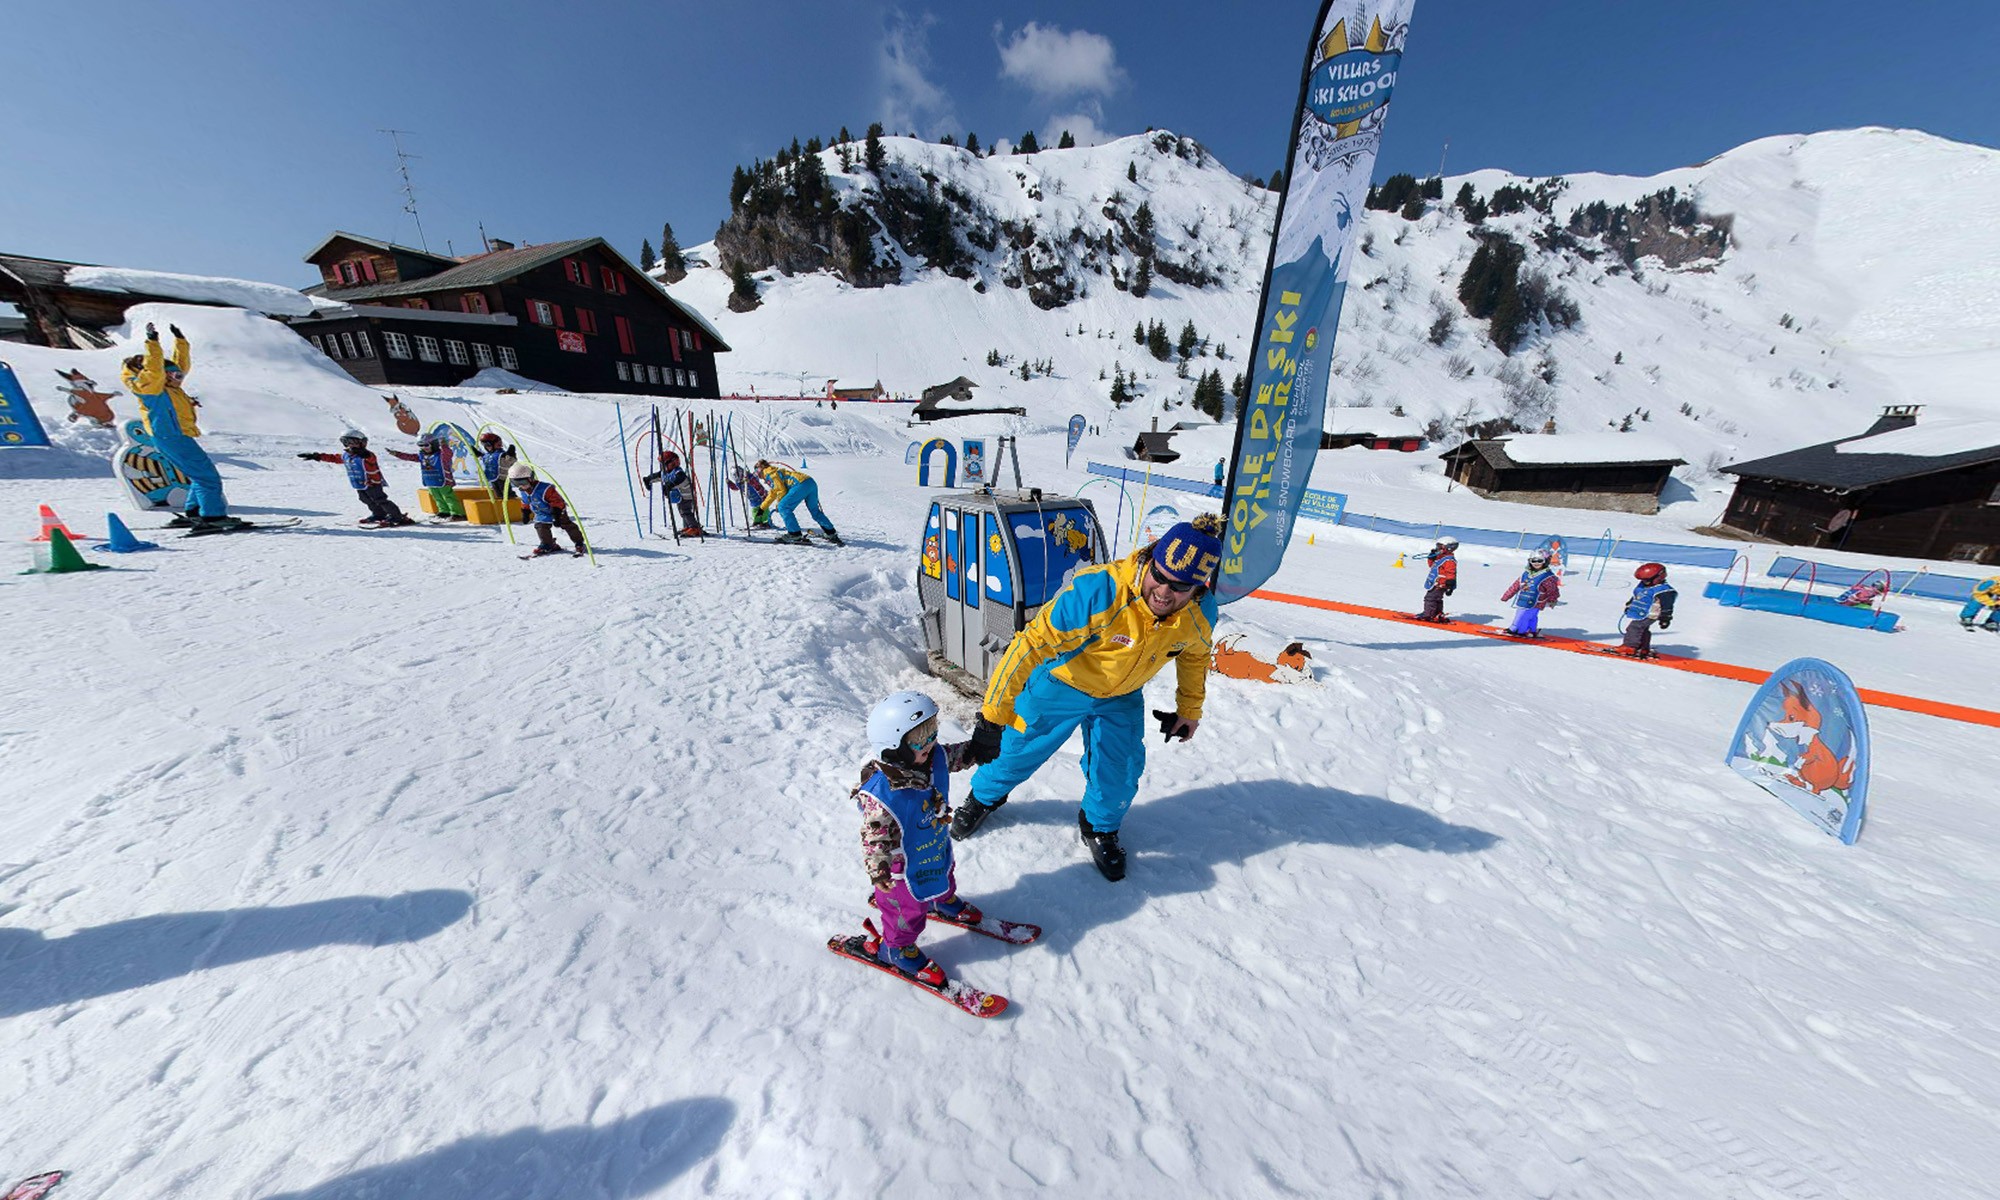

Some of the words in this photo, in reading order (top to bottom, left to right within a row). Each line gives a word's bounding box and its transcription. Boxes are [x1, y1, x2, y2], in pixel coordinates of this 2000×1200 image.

[1328, 59, 1381, 80] VILLARS
[1250, 384, 1274, 439] DE
[1267, 290, 1302, 370] SKI
[1279, 419, 1296, 507] SNOWBOARD
